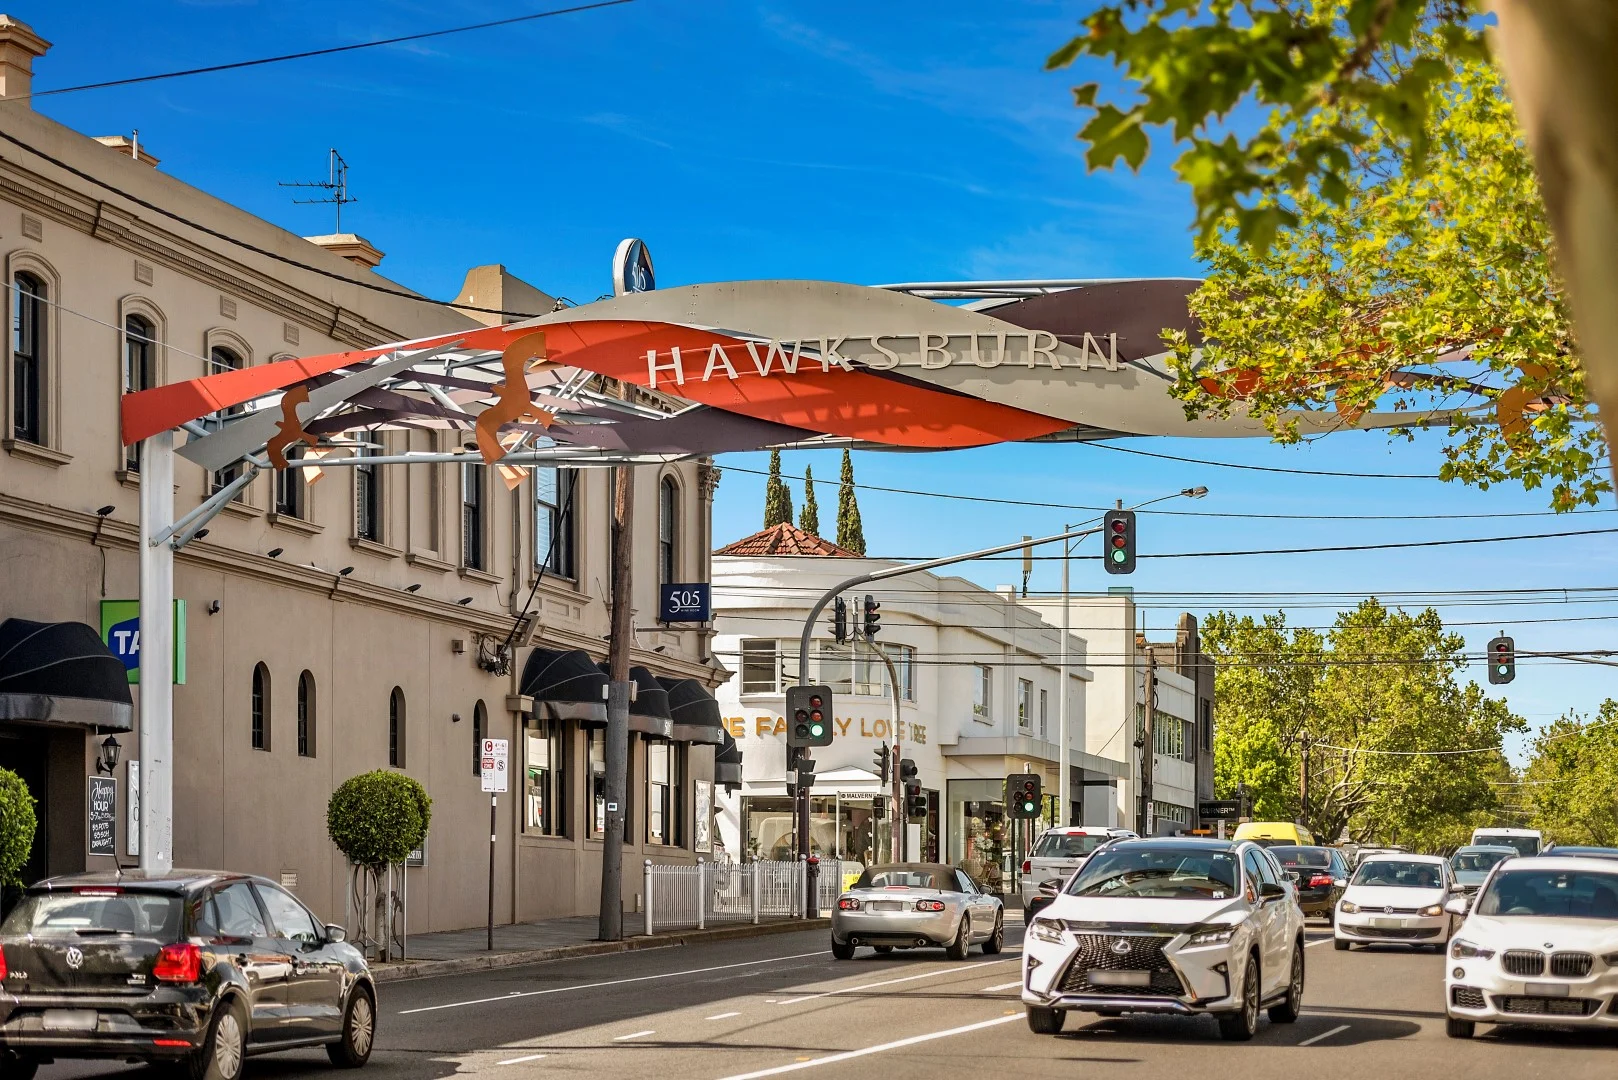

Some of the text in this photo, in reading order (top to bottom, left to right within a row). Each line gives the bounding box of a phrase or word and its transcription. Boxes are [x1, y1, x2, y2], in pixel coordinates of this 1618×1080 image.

[646, 329, 1118, 388] HAWKSBURN
[669, 590, 701, 613] 505
[91, 781, 114, 805] Happy
[93, 800, 109, 812] HOUR
[92, 836, 113, 848] DRAUGHT
